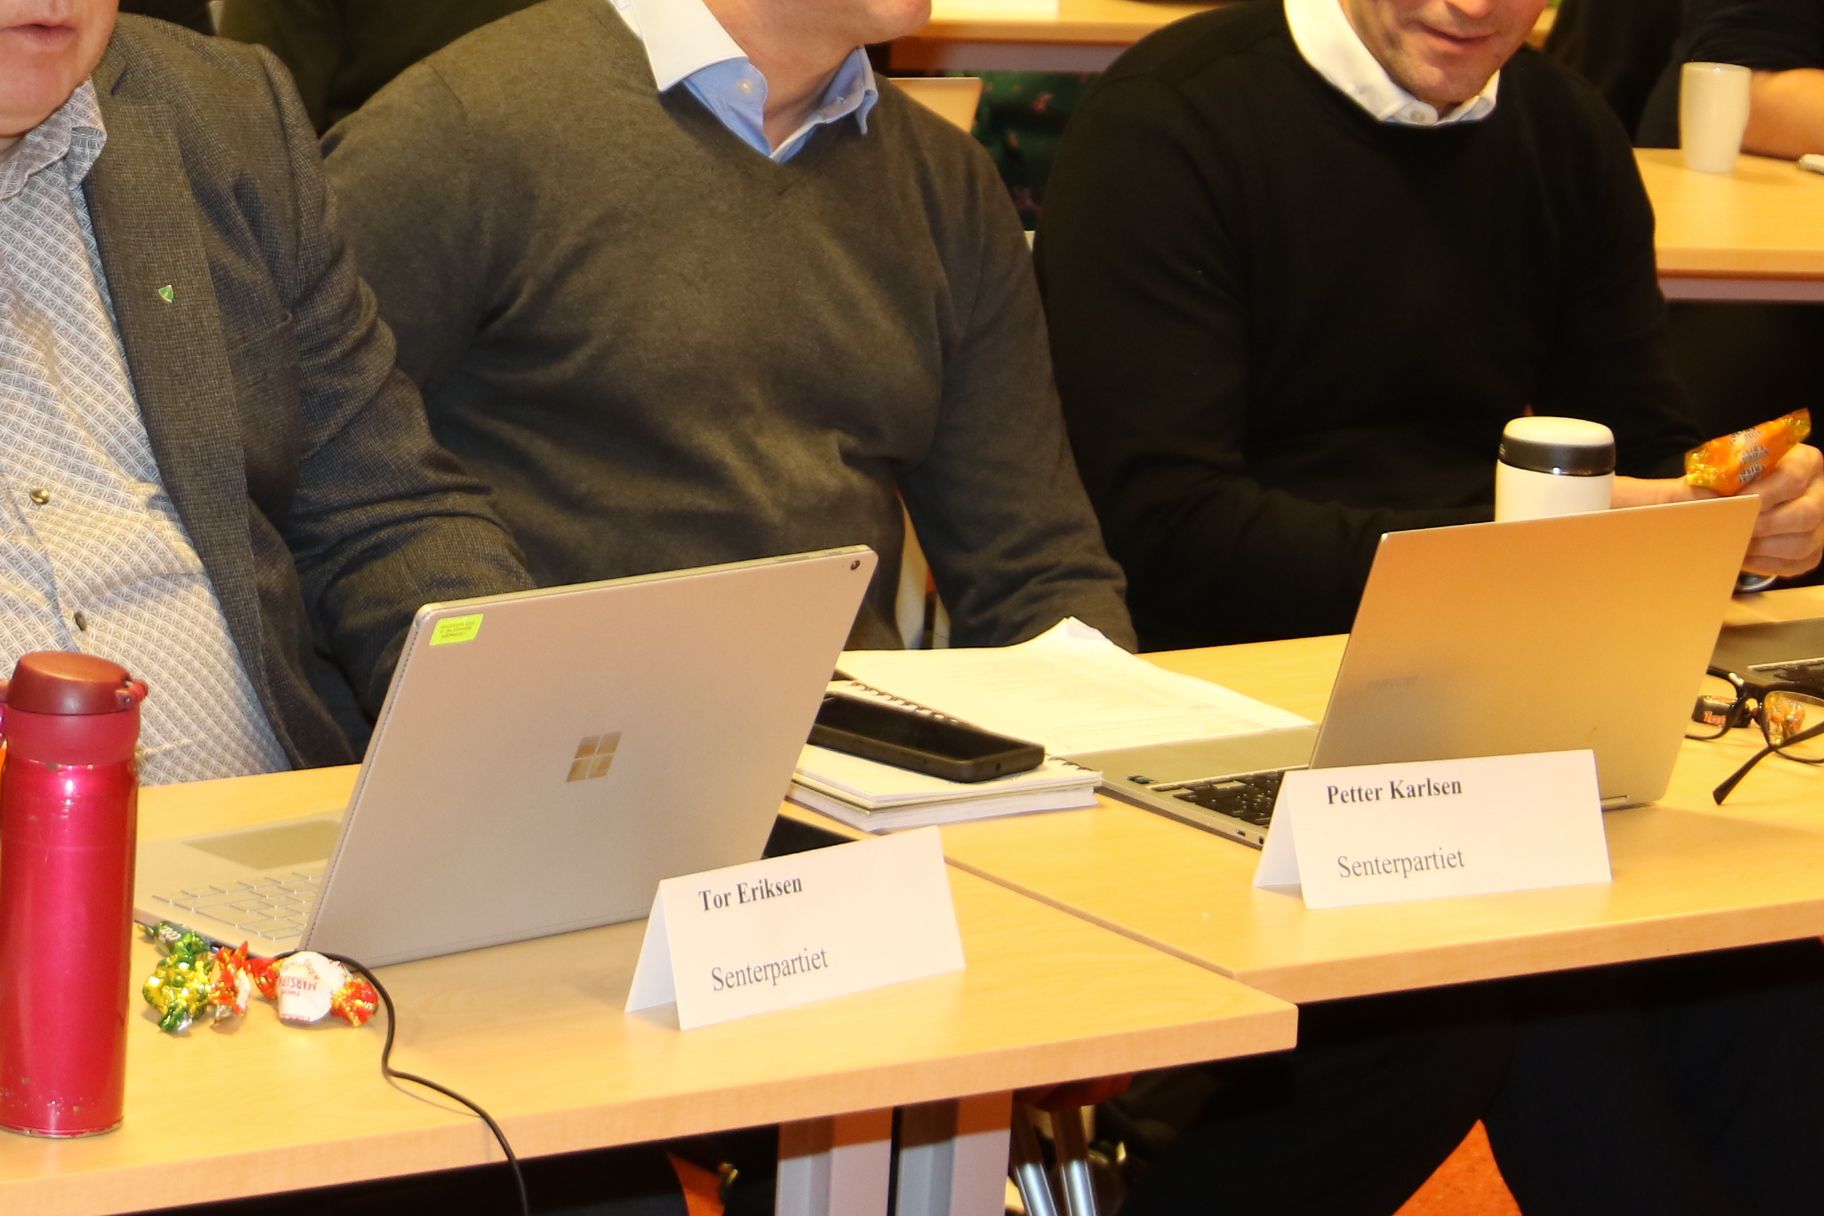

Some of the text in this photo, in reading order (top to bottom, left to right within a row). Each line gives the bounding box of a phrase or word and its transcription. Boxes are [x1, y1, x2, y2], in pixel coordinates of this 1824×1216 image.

[1327, 778, 1463, 806] Petter Karlsen
[1337, 847, 1466, 879] Senterpartiet
[698, 876, 804, 912] Tor Eriksen
[710, 947, 829, 993] Senterpartiet
